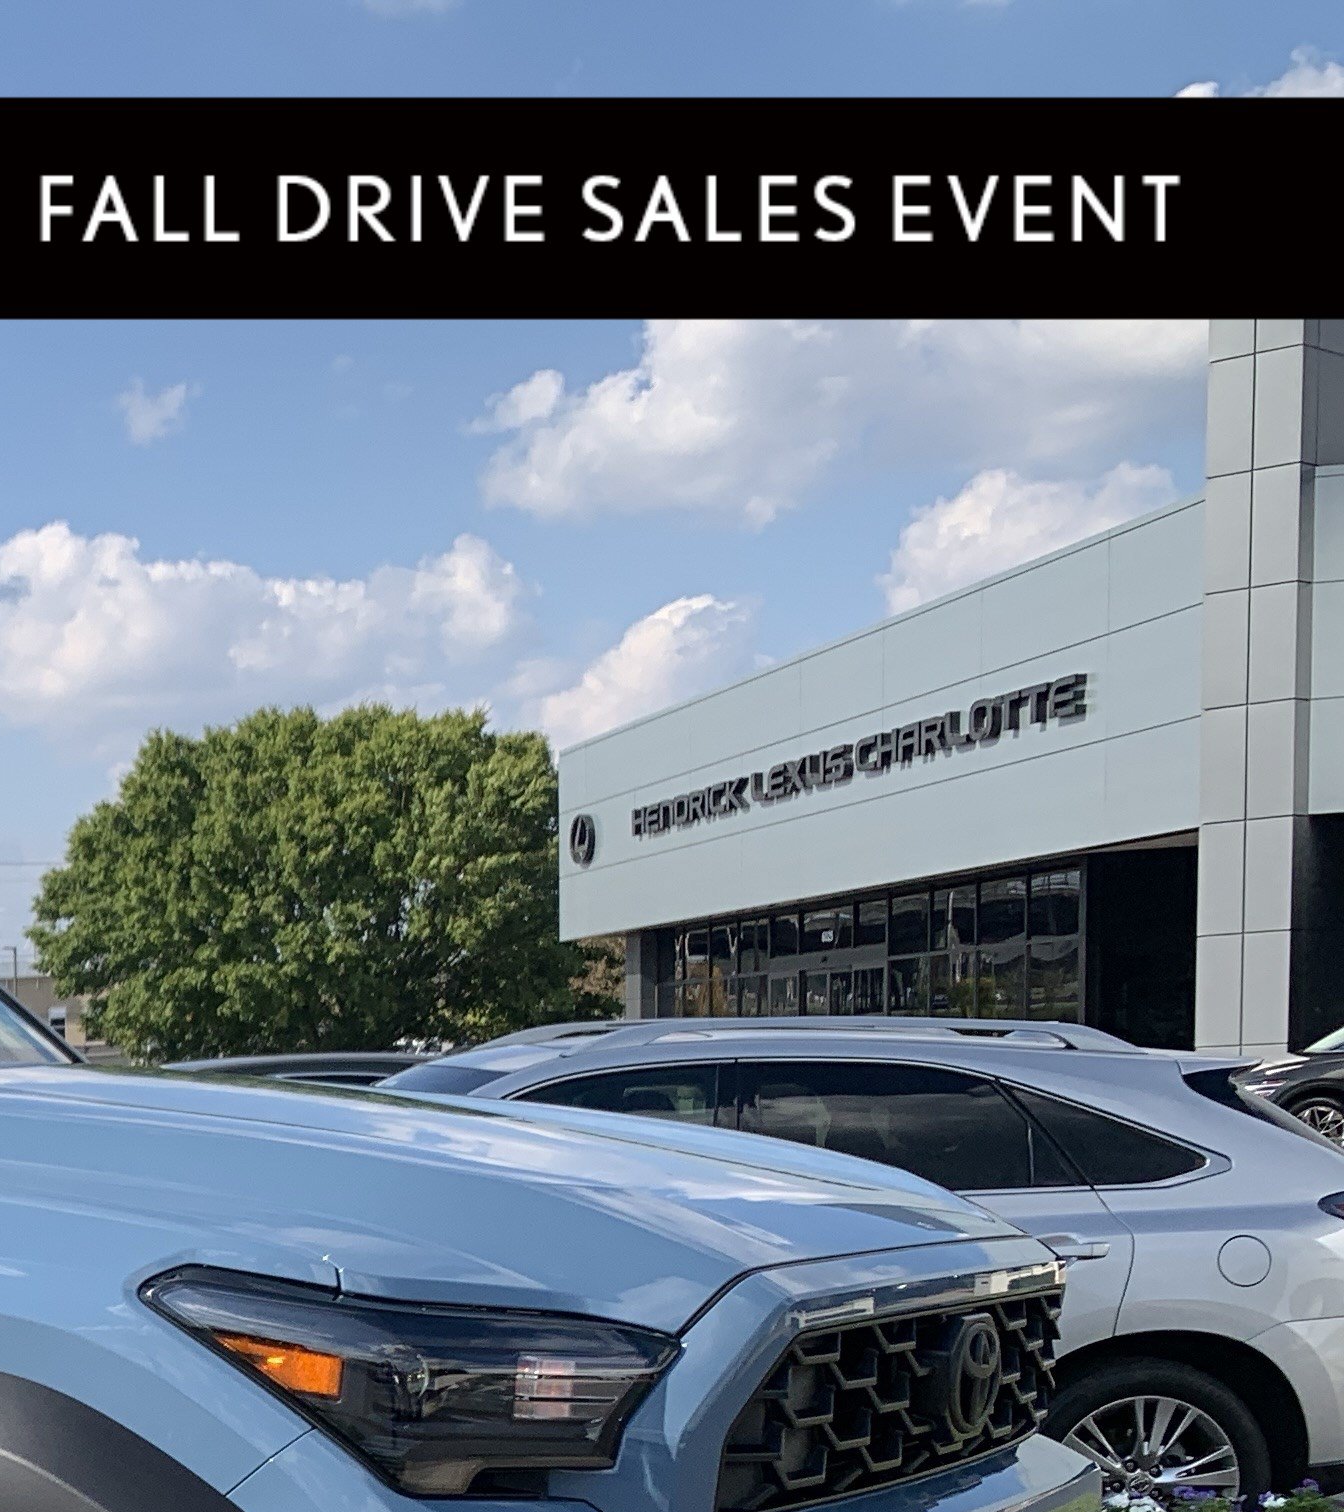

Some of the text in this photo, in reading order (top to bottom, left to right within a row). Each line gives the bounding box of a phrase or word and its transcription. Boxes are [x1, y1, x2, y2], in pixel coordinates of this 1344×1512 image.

[631, 673, 1088, 836] HENDRICK LEXUS CHARLOTTE
